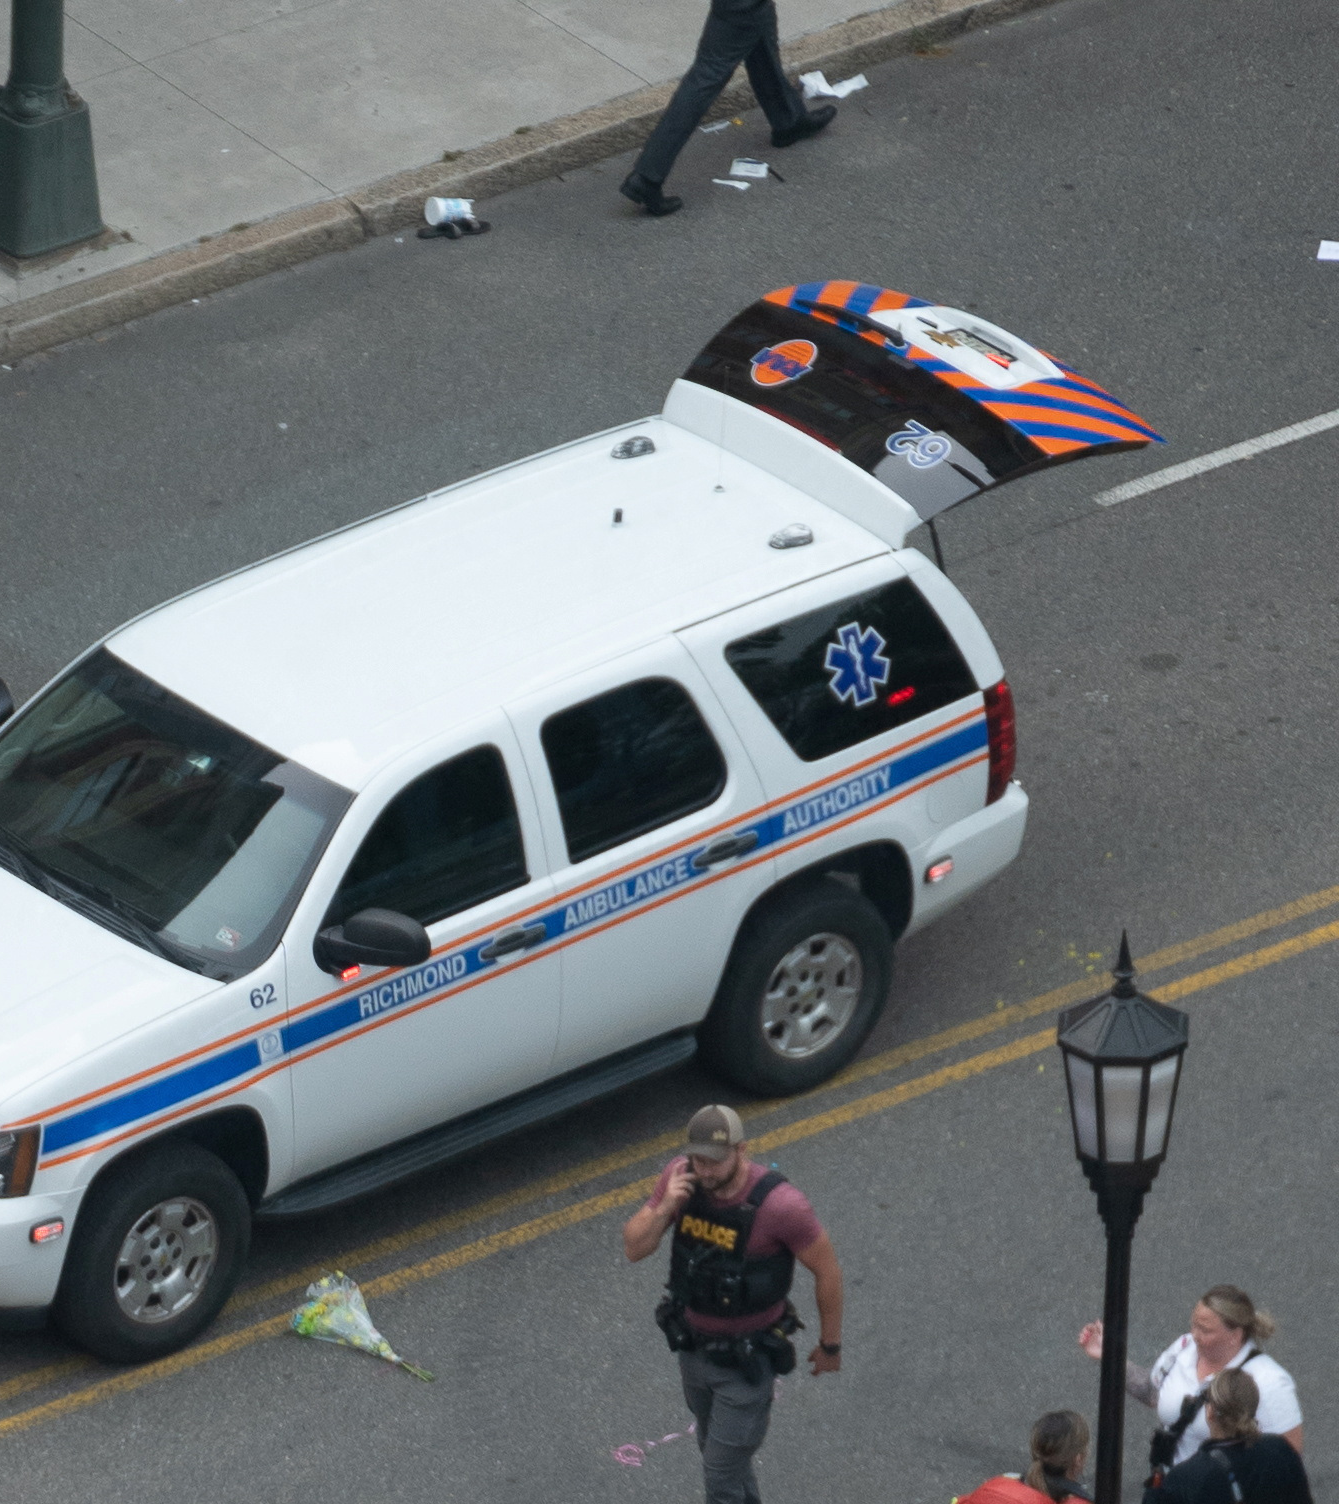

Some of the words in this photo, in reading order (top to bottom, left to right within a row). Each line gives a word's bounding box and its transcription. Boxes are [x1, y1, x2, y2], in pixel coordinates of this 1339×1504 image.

[358, 954, 466, 1018] RICHMOND
[563, 857, 689, 931] AMBULANCE
[782, 766, 892, 835] AUTHORITY
[250, 983, 277, 1009] 62
[680, 1215, 738, 1251] POLICE
